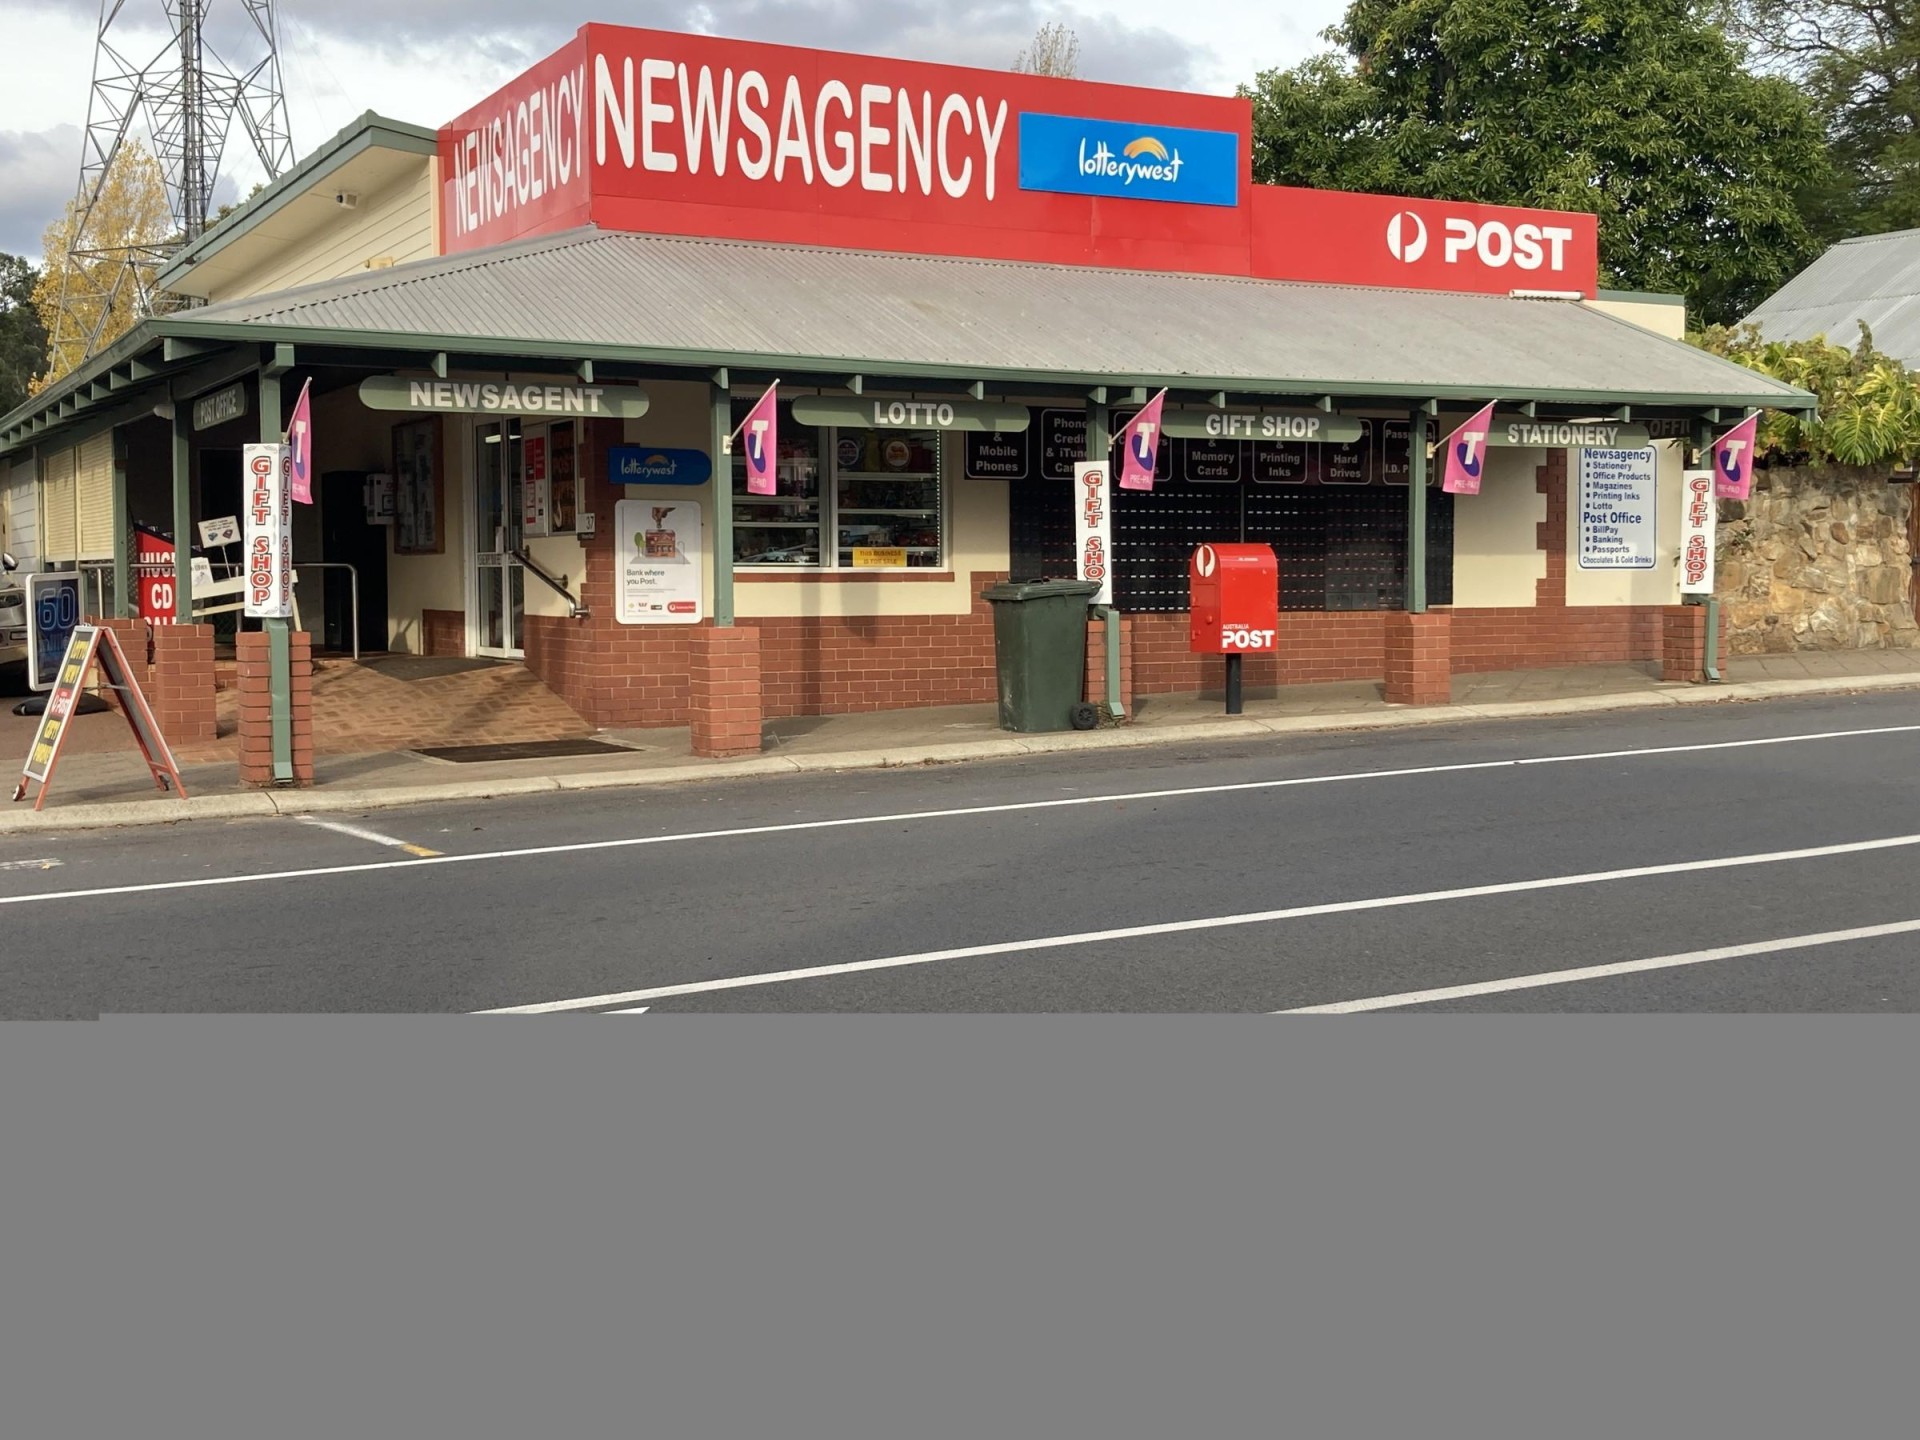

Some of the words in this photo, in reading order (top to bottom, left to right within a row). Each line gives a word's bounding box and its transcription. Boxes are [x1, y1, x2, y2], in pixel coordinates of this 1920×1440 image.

[595, 53, 1008, 202] NEWSAGENCY
[453, 63, 584, 237] NEWSAGENCY
[1079, 136, 1184, 186] lotterywest
[1445, 217, 1573, 271] POST
[410, 381, 604, 413] NEWSAGENT
[200, 398, 215, 426] POST
[215, 389, 237, 420] OFFICE
[874, 401, 954, 426] LOTTO
[1206, 413, 1256, 436] GIFT
[1261, 415, 1320, 438] SHOP
[1054, 433, 1087, 443] Credi
[1508, 424, 1619, 446] STATIONERY
[979, 446, 1018, 457] Mobile
[1046, 448, 1054, 457] &
[1060, 448, 1087, 458] iTun
[1192, 451, 1235, 464] Memory
[1584, 448, 1652, 463] Newsagency
[1260, 453, 1300, 464] Printing
[1333, 455, 1358, 464] Hard
[620, 456, 677, 478] lotterywest
[976, 461, 1018, 472] Phones
[1055, 463, 1075, 473] Car
[1197, 466, 1229, 476] Cards
[1269, 467, 1291, 477] Inks
[1592, 461, 1632, 471] Stationery
[1330, 468, 1361, 478] Drives
[1593, 472, 1616, 480] Office
[1618, 472, 1651, 480] Products
[250, 456, 271, 525] GIFT
[281, 456, 291, 526] GIFT
[1592, 482, 1632, 491] Magazines
[1083, 470, 1103, 528] GIFT
[1592, 492, 1622, 501] Printing
[1624, 492, 1640, 500] Inks
[1690, 478, 1710, 527] GIFT
[1592, 502, 1613, 510] Lotto
[1583, 512, 1607, 523] Post
[1610, 512, 1642, 524] Office
[1592, 526, 1618, 535] BillPay
[1592, 535, 1623, 545] Banking
[1592, 545, 1630, 554] Passports
[1084, 536, 1106, 588] SHO
[1582, 556, 1613, 564] Chocolates
[1621, 556, 1633, 564] Cold
[1634, 556, 1652, 564] Drinks
[1685, 535, 1707, 585] SHOP
[250, 536, 273, 606] SHOP
[626, 568, 643, 576] Bank
[644, 569, 665, 577] where
[151, 583, 173, 610] CD
[38, 586, 76, 631] 60
[1222, 630, 1275, 649] POST
